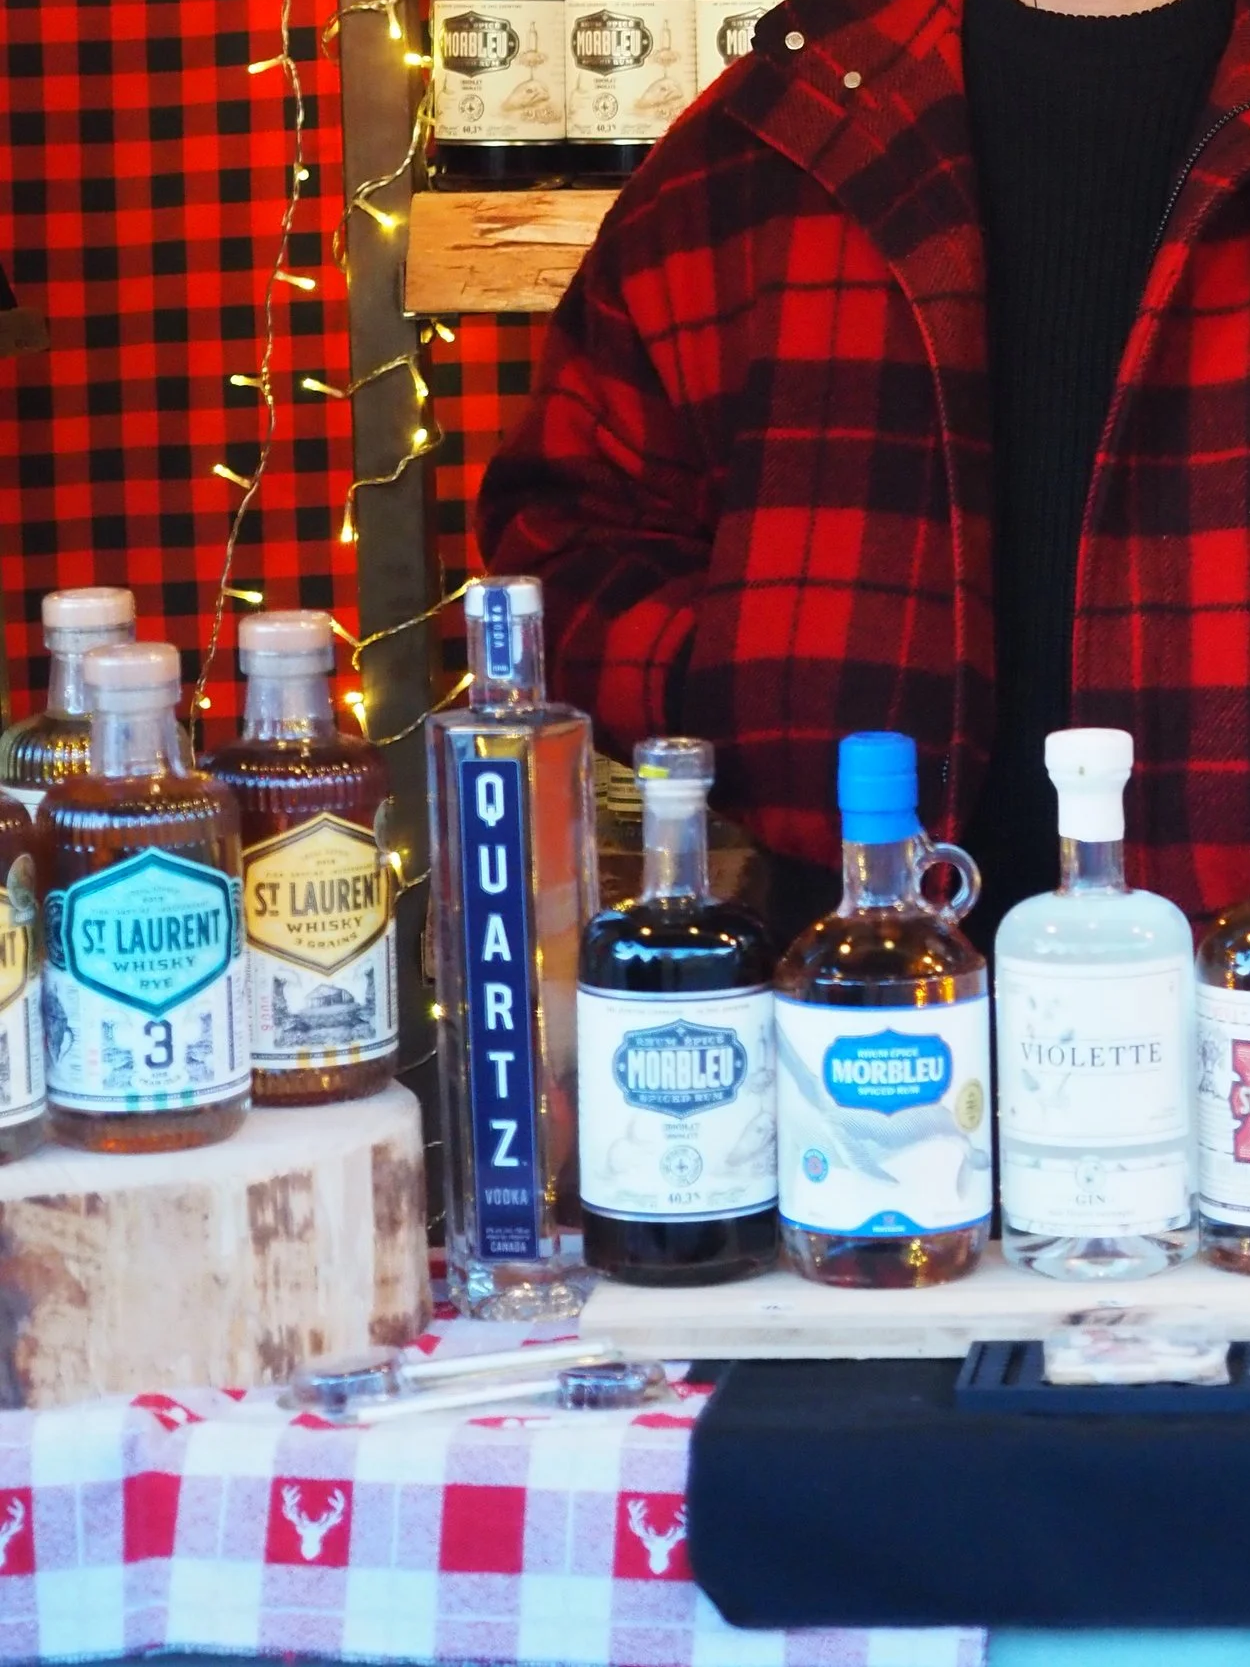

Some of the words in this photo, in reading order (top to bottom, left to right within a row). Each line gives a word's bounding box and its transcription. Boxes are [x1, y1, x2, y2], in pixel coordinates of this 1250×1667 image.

[443, 31, 508, 58] MORBLEU
[576, 30, 641, 57] MORBLEU
[290, 871, 382, 918] LAURENT
[116, 907, 221, 956] LAURENT
[285, 915, 364, 934] WHISKY
[306, 933, 359, 950] GRAINS
[113, 955, 196, 973] WHISKY
[473, 771, 522, 1169] QUARTZ
[139, 977, 174, 990] RYE
[143, 1018, 174, 1070] 3
[1020, 1040, 1163, 1068] VIOLETTE
[627, 1046, 734, 1091] MORBLEU
[831, 1056, 944, 1085] MORBLEU
[484, 1188, 529, 1206] VODKA
[1075, 1194, 1106, 1206] GIN
[490, 1240, 528, 1253] CANADA
